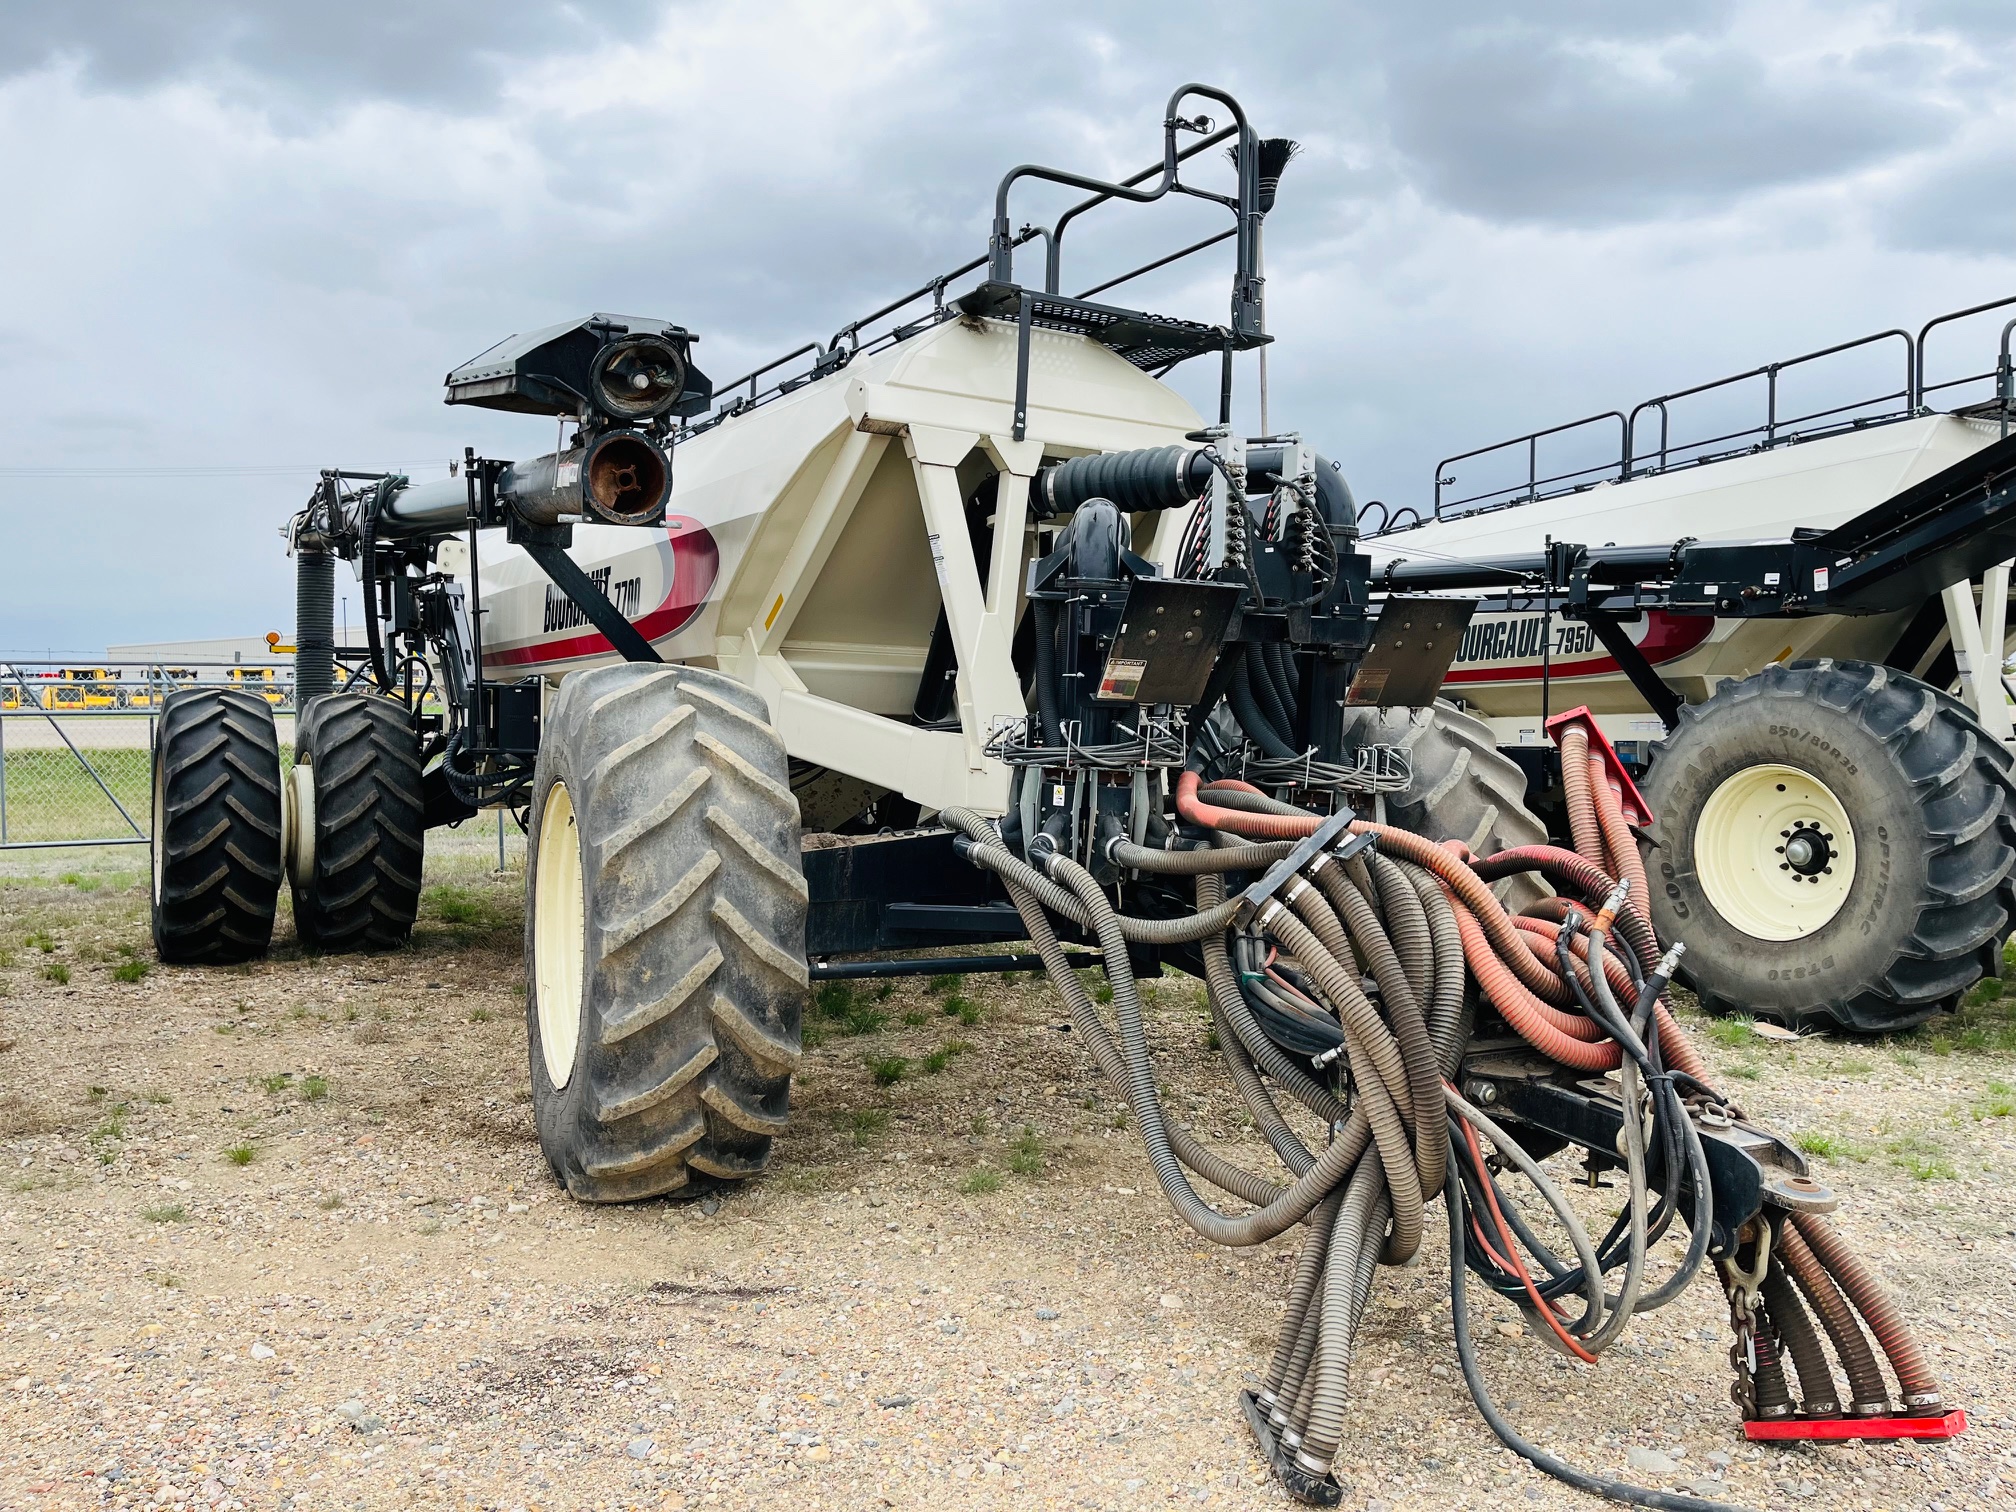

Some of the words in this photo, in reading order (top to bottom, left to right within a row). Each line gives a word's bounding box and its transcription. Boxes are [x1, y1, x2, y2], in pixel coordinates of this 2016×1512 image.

[614, 577, 641, 617] 7700
[1456, 616, 1552, 663] OURGAULT
[1556, 625, 1596, 655] 7950
[1768, 724, 1859, 776] 850/80R38
[1660, 745, 1718, 920] GOODYEAR
[1860, 825, 1891, 937] OPTITRAC
[1767, 955, 1835, 981] DT830
